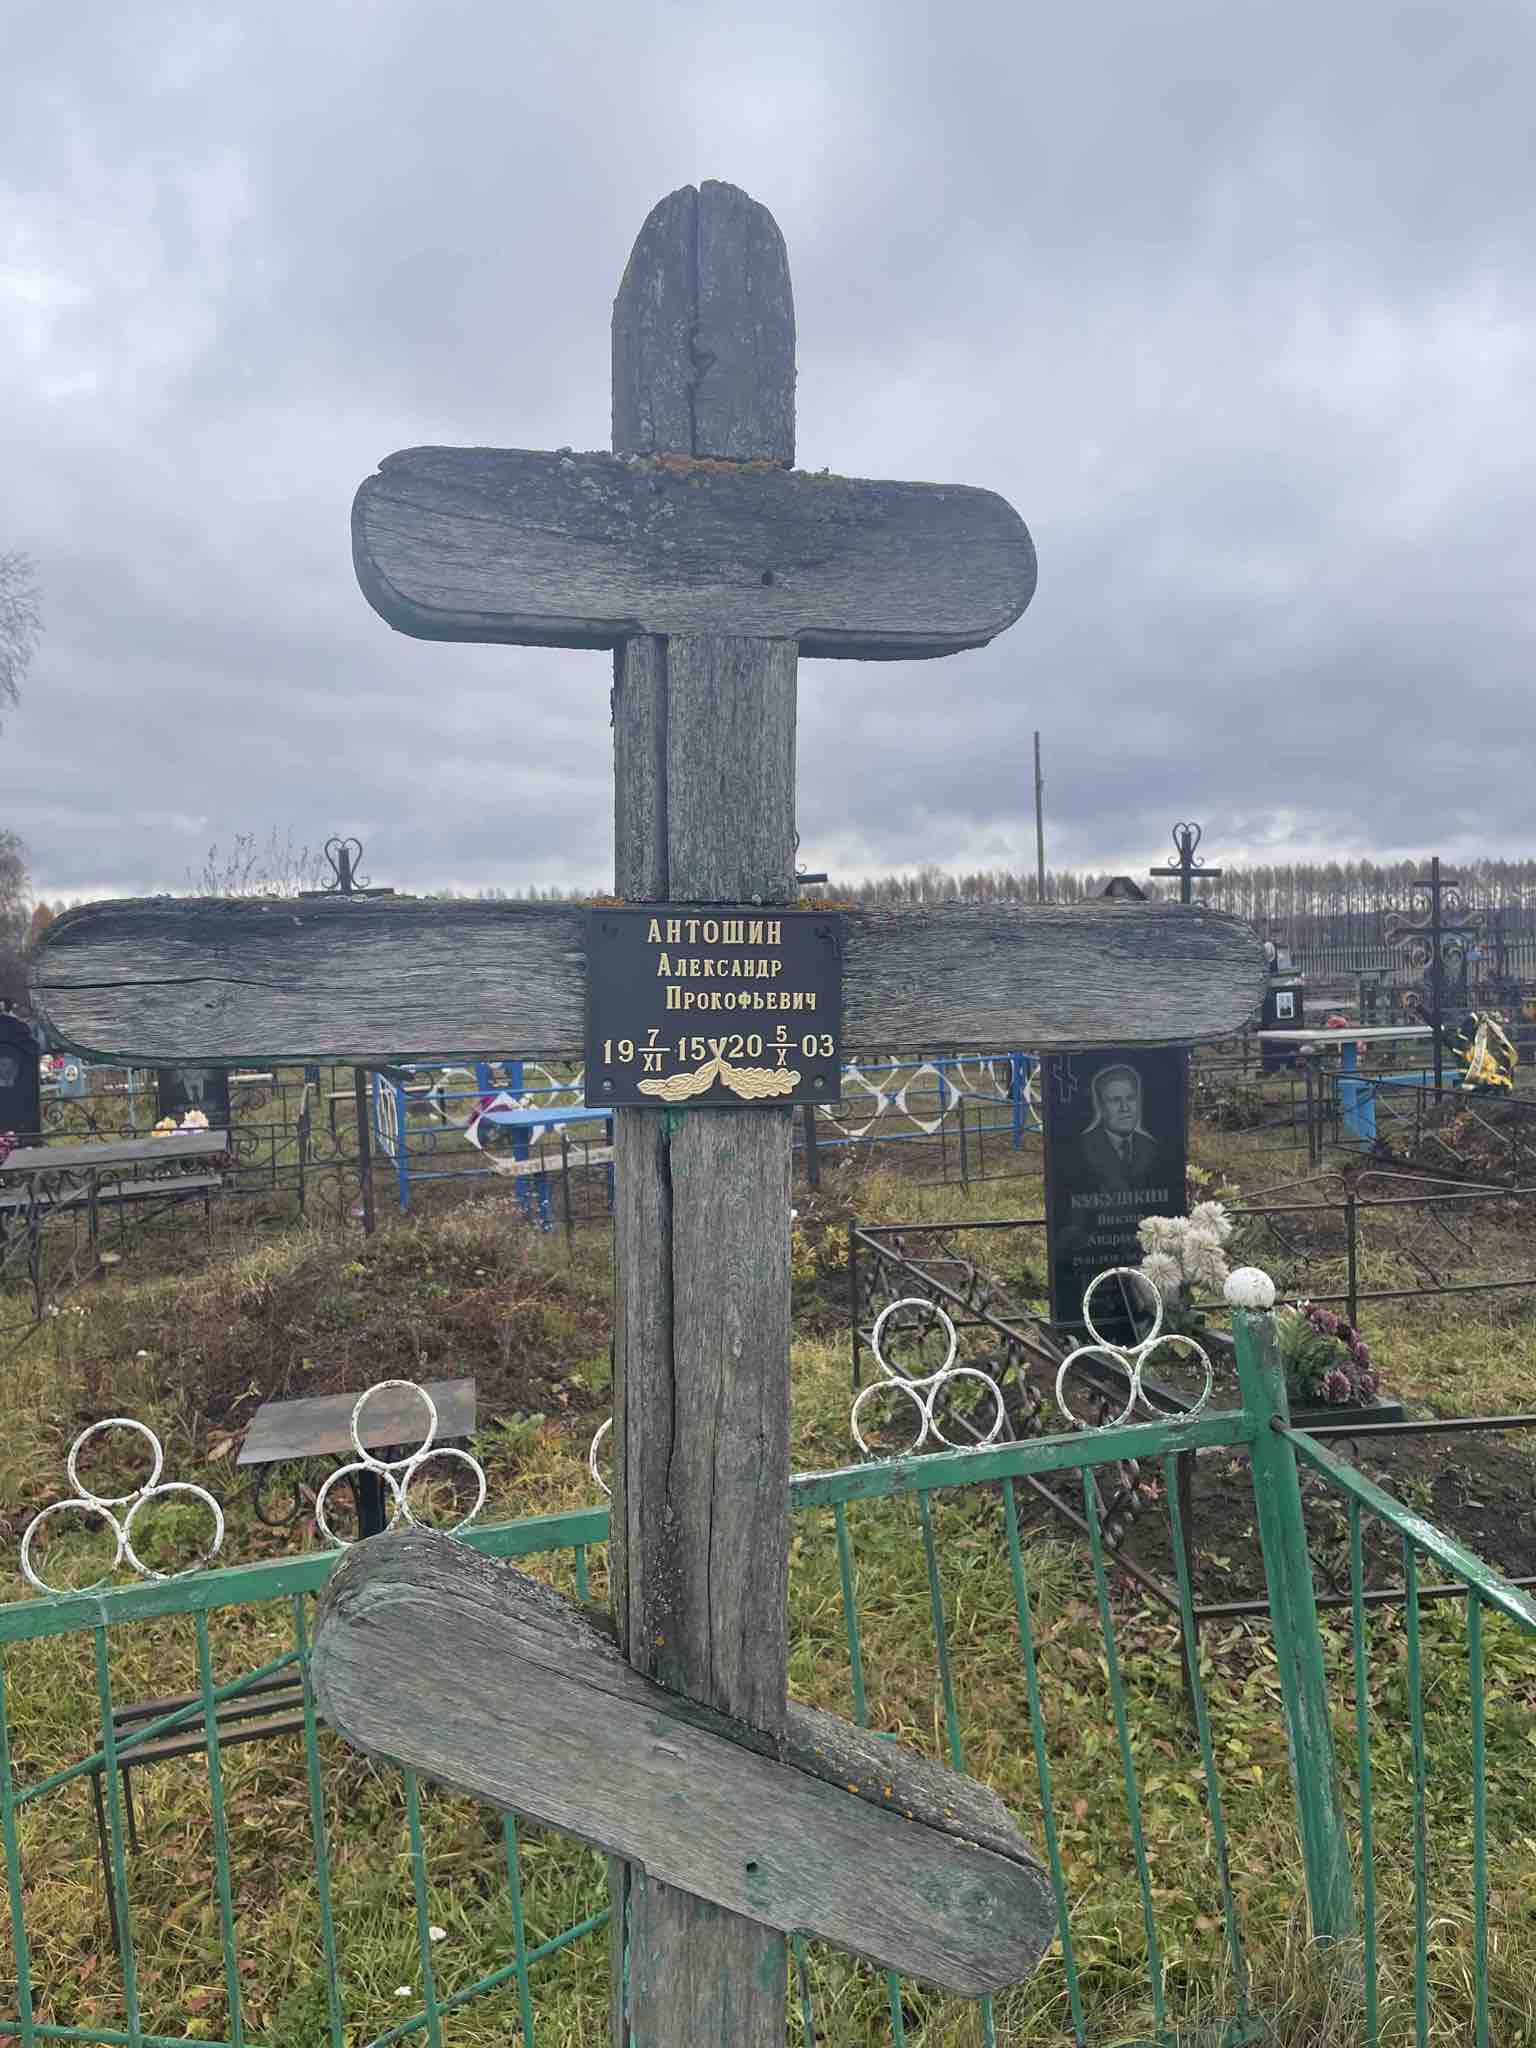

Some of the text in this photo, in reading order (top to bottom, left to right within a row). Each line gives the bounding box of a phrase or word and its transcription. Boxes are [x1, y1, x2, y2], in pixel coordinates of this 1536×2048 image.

[647, 918, 782, 945] АНТОШИН
[603, 1039, 635, 1064] 19
[647, 1029, 661, 1048] 7
[678, 1037, 707, 1062] 15
[728, 1034, 763, 1059] 20
[775, 1025, 788, 1043] 5
[802, 1034, 835, 1058] 03
